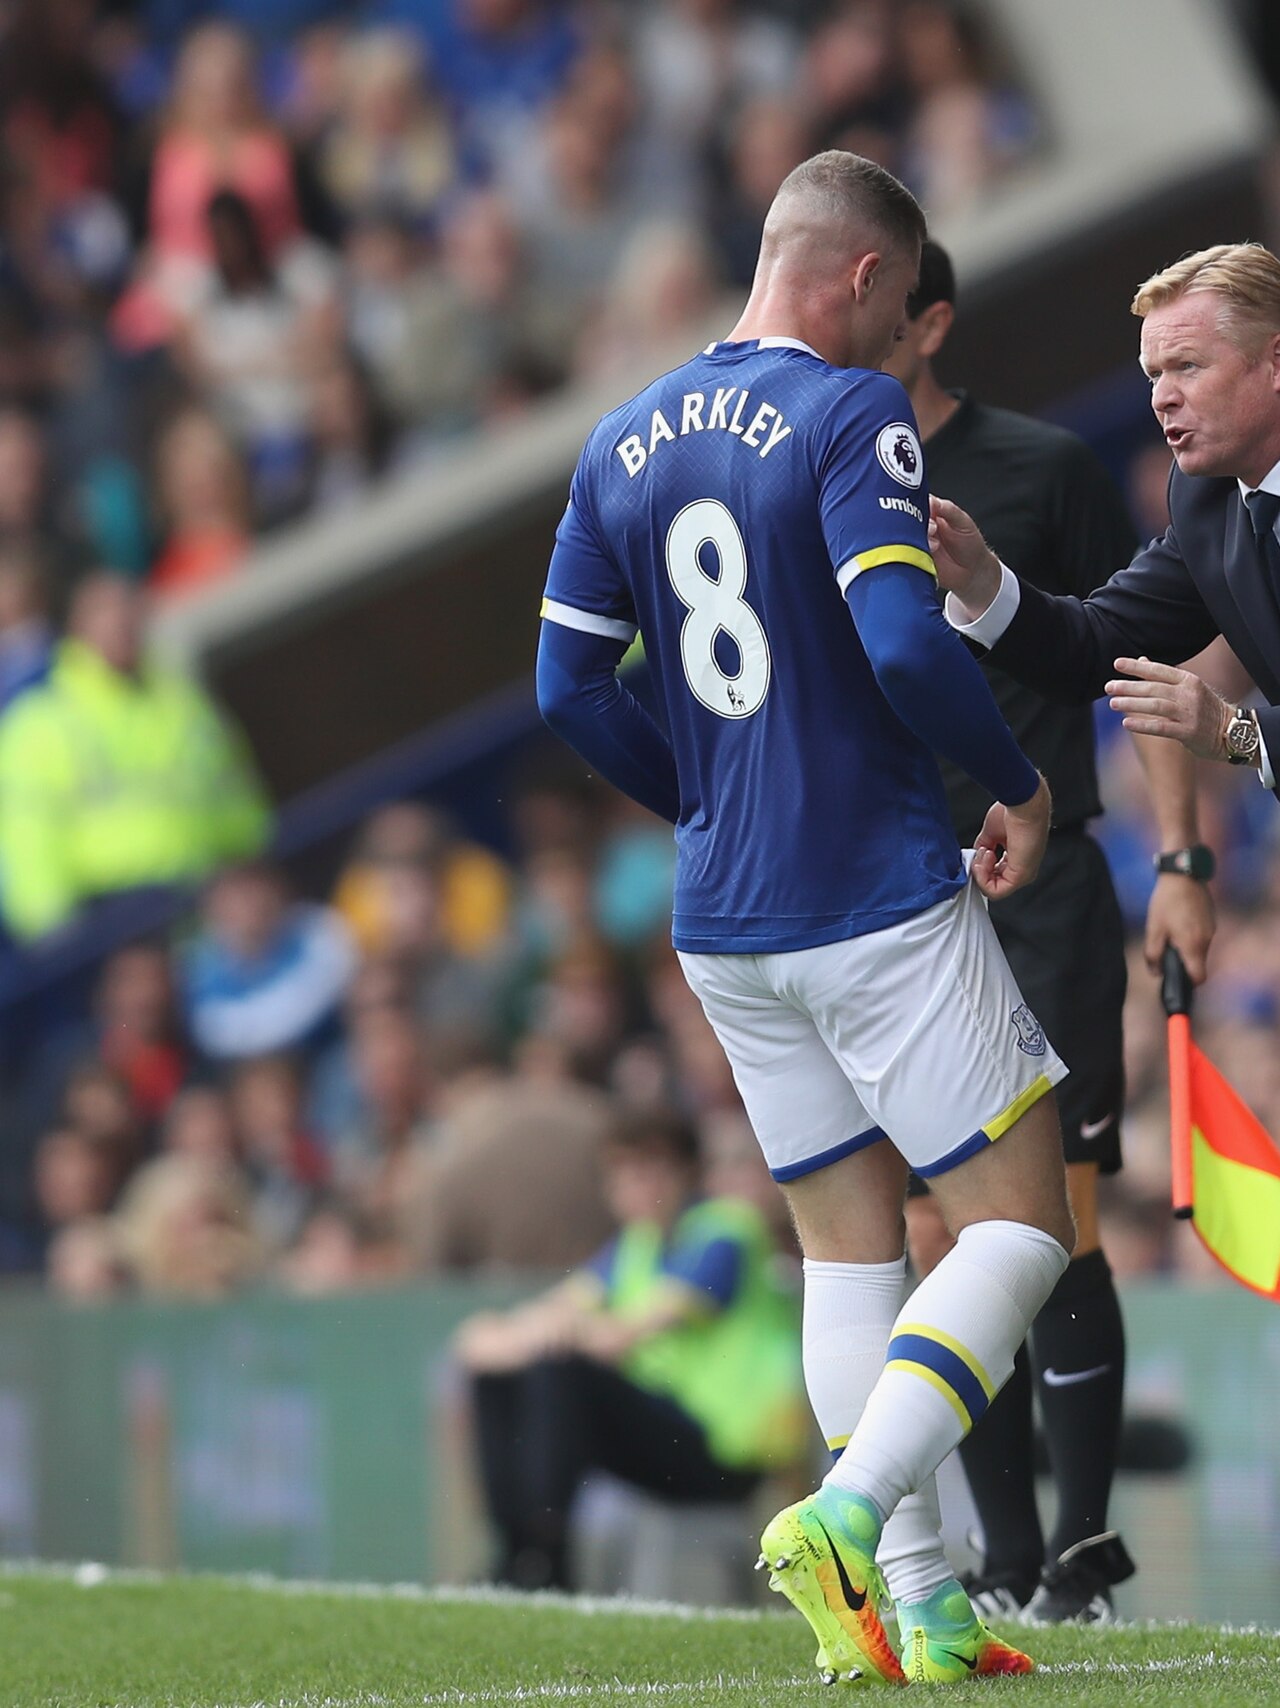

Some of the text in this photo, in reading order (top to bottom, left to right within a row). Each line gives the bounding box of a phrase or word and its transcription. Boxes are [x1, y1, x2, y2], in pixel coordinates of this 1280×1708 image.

[616, 387, 792, 479] BARKLEY
[878, 497, 923, 522] umbro
[666, 498, 771, 719] 8
